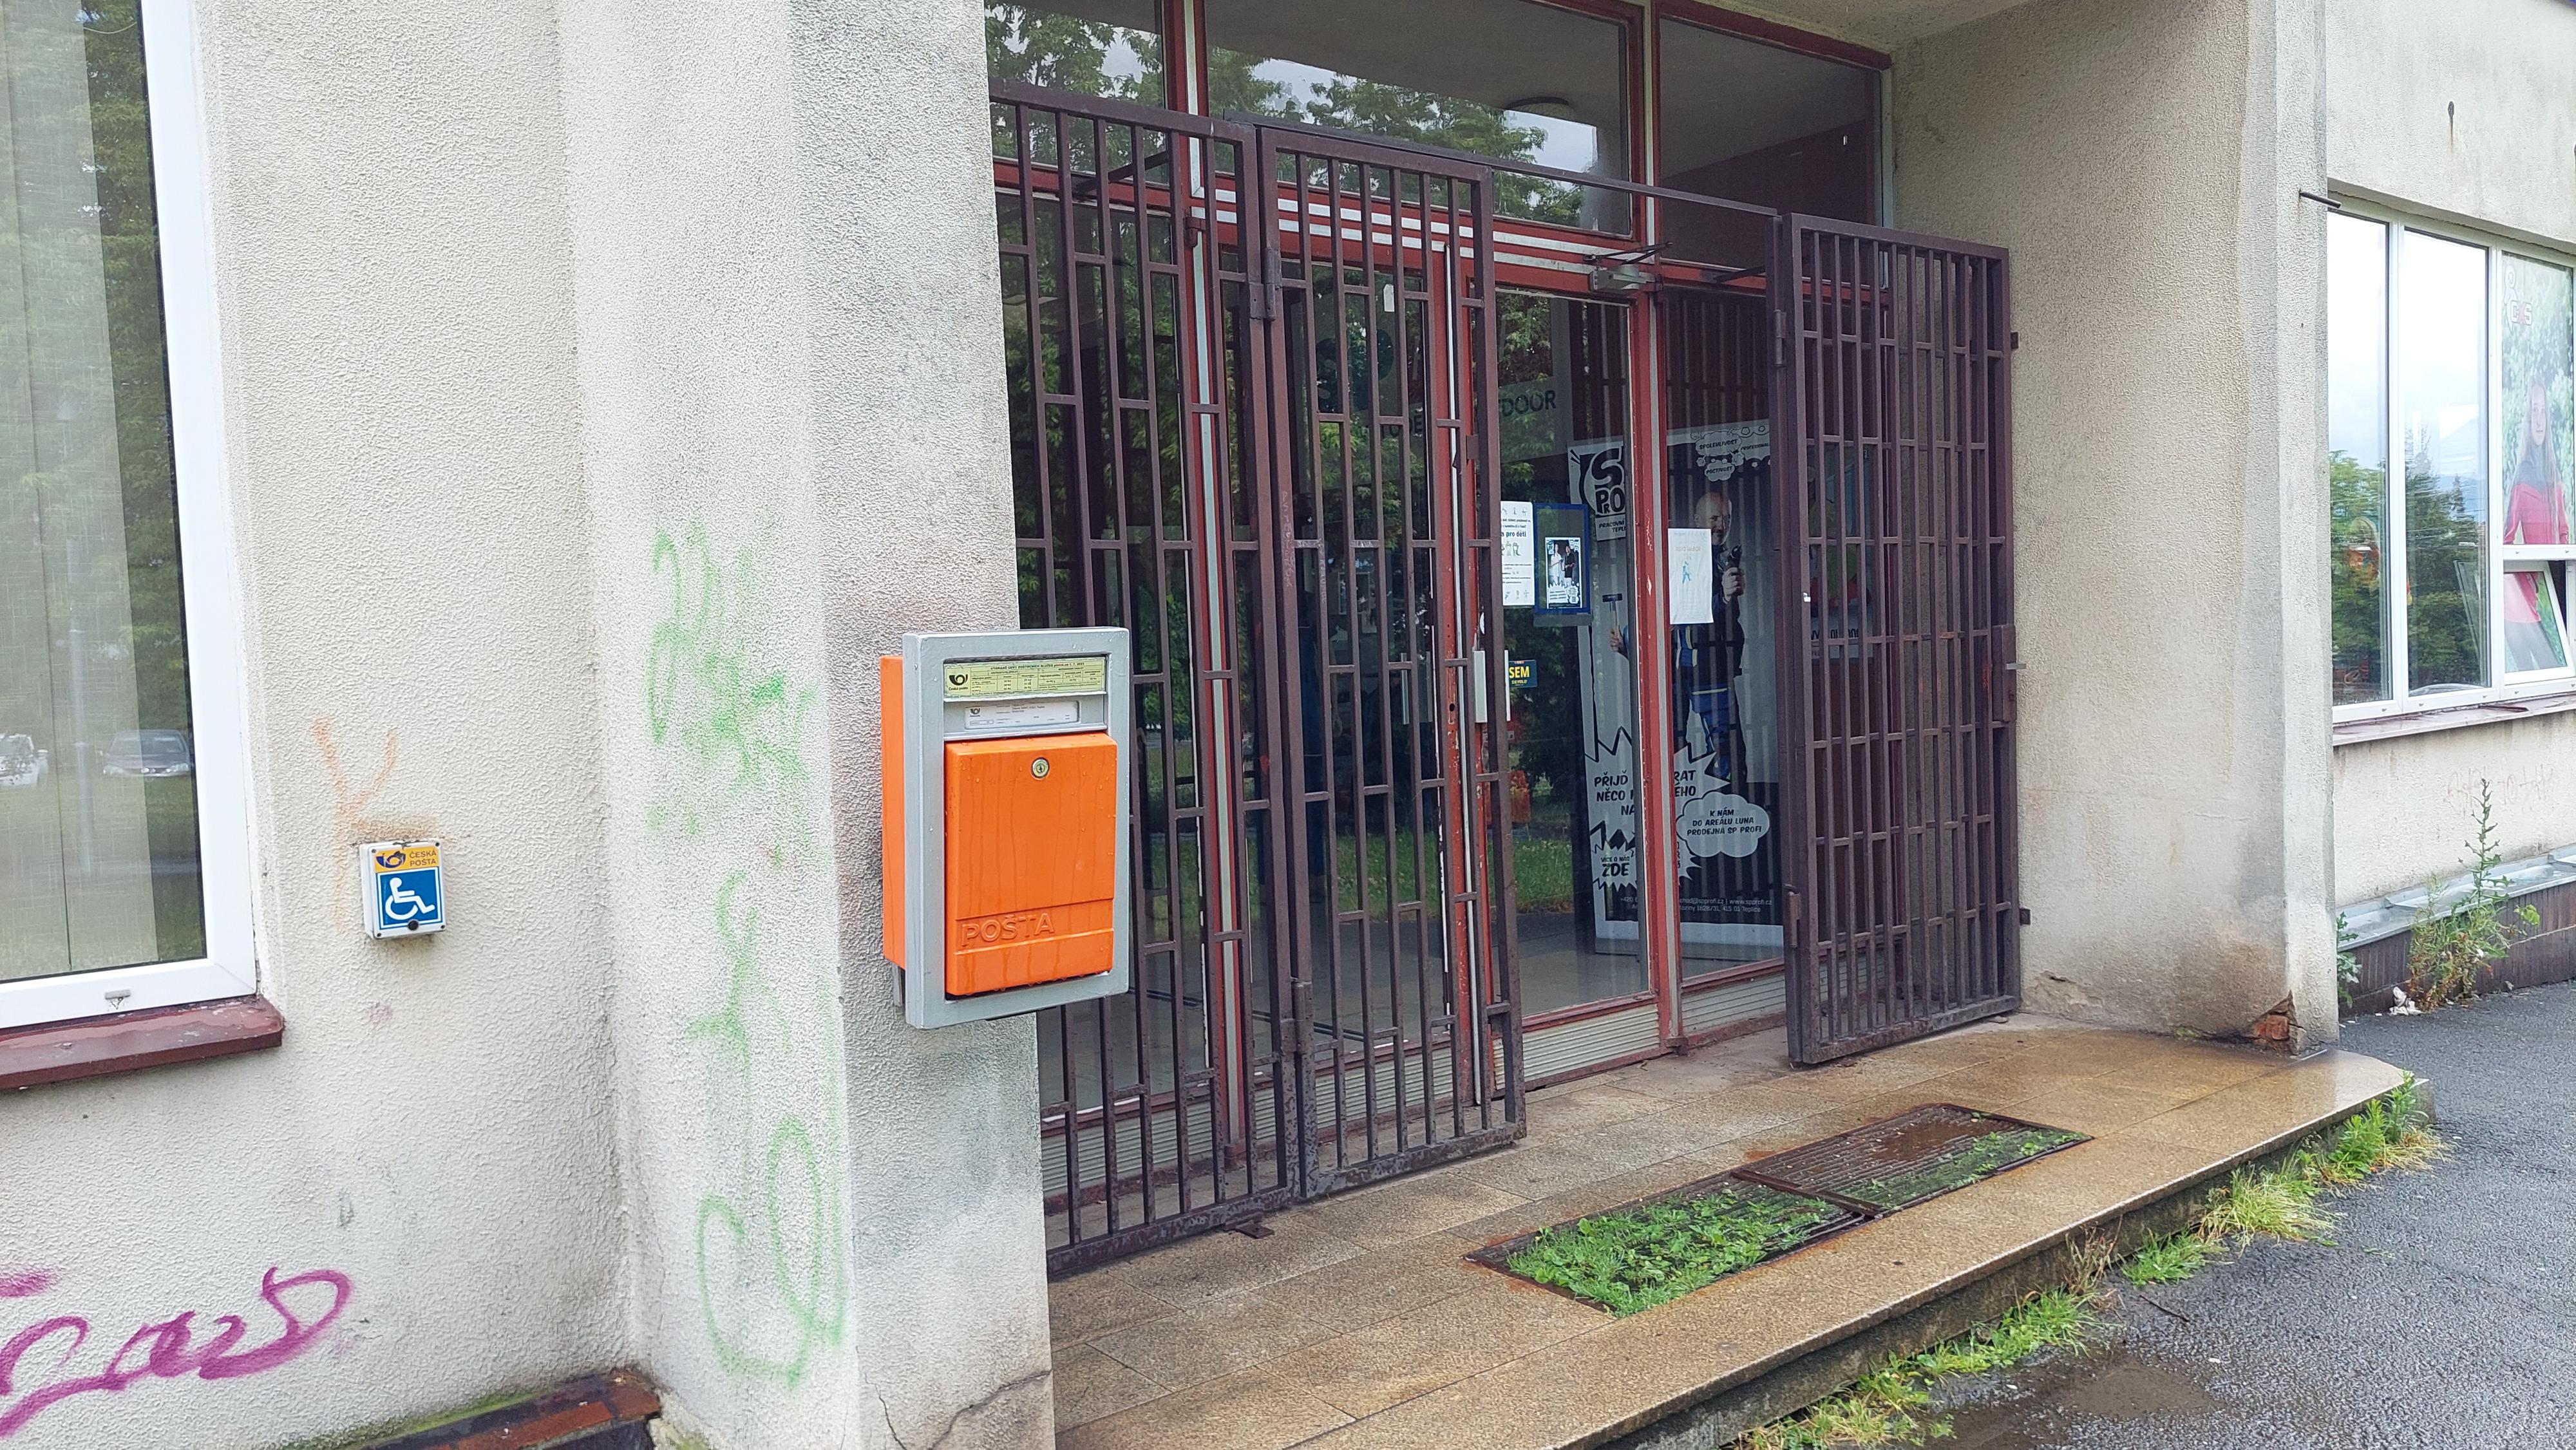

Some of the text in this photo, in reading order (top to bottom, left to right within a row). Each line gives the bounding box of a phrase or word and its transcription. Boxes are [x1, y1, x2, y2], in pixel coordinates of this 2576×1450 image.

[2510, 299, 2532, 326] CXS
[1499, 390, 1557, 417] DOOR
[1699, 438, 1738, 449] SPOLEHLIVOST
[1509, 666, 1530, 678] SEM
[1594, 769, 1628, 787] PŘIJĎ
[1596, 787, 1625, 802] NĚCO
[1674, 782, 1696, 796] ÉHO
[1717, 807, 1734, 816] NÁM
[1705, 816, 1732, 826] AREÁLU
[409, 848, 437, 859] ČESKÁ
[410, 858, 437, 867] POŠTA
[1602, 862, 1630, 877] ZDE
[961, 912, 1055, 947] POŠTA
